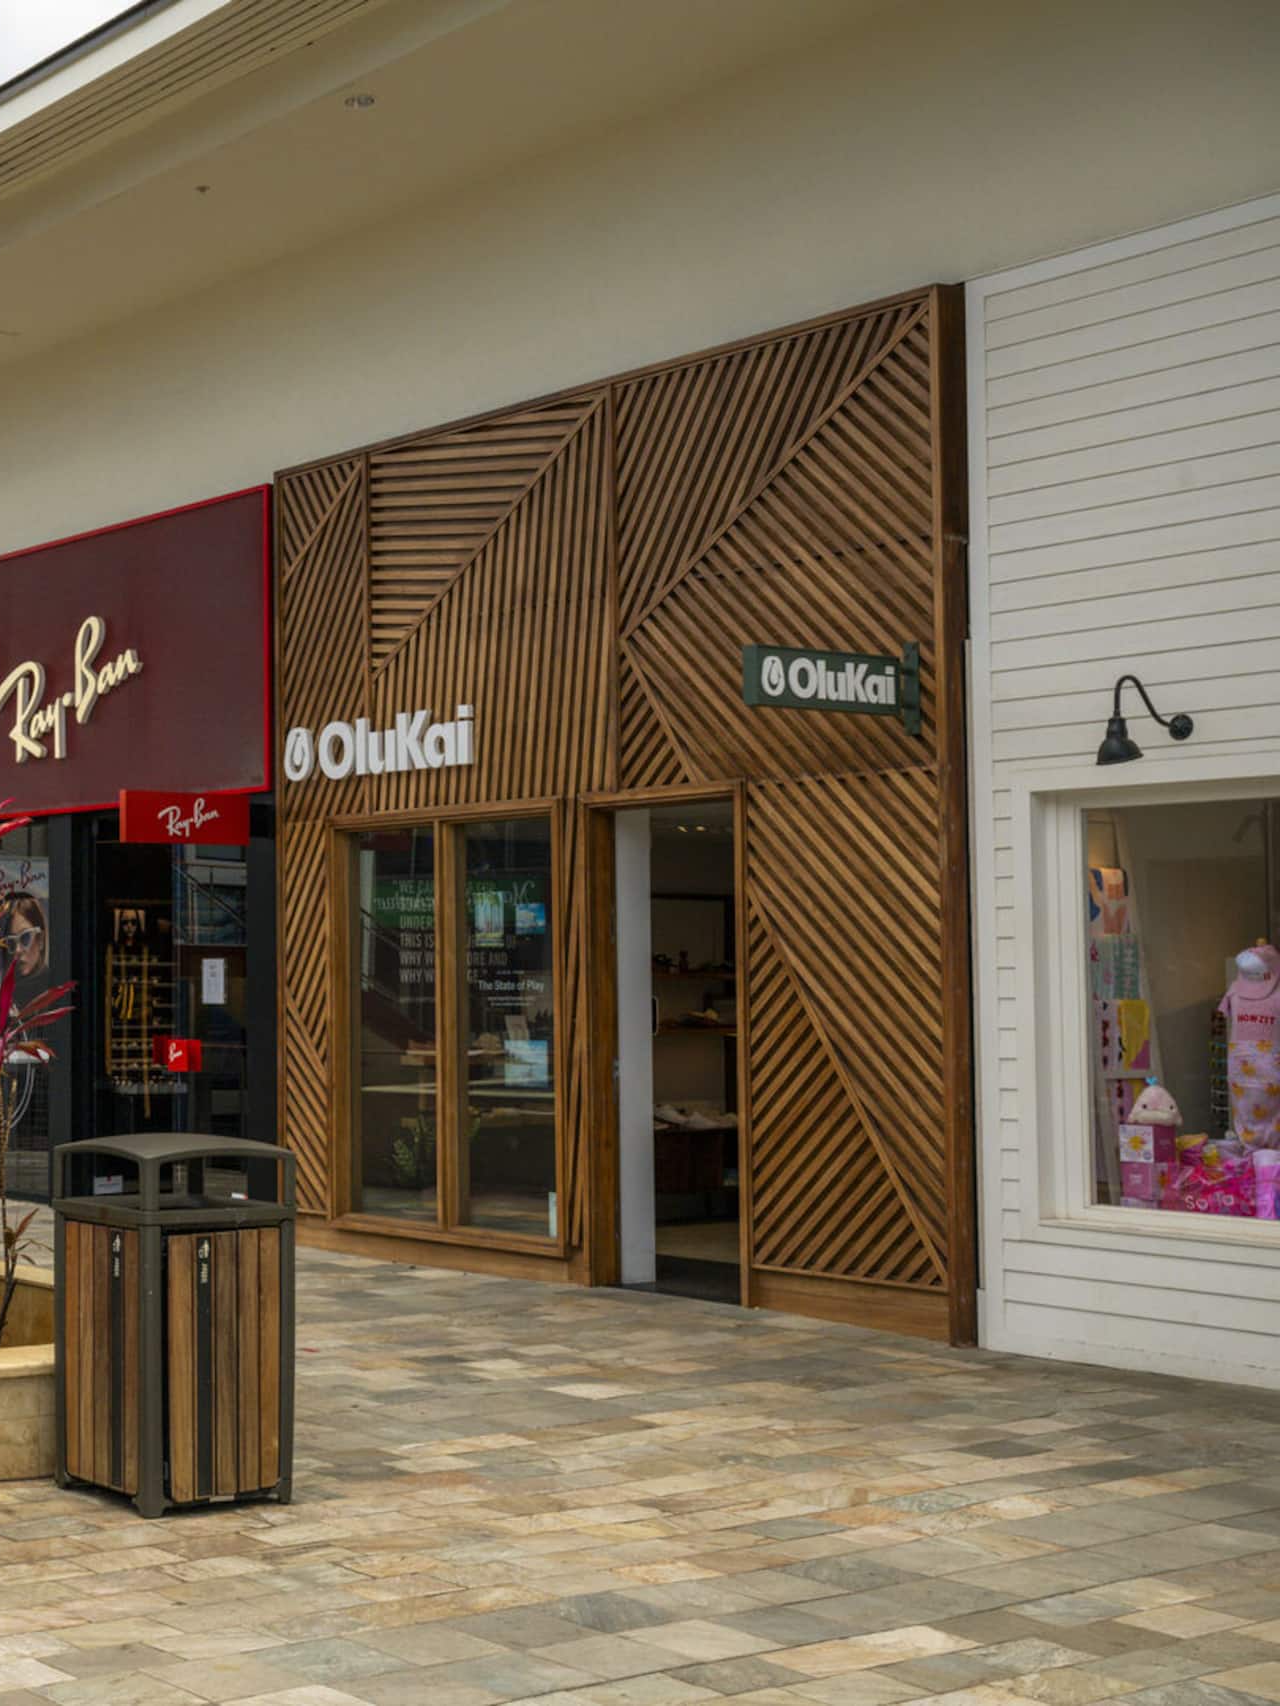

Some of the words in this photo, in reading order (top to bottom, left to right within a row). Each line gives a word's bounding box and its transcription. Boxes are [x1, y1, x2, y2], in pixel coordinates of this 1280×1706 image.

[788, 657, 896, 704] OluKai
[319, 704, 473, 780] OluKai
[479, 981, 493, 991] The
[494, 981, 516, 991] State
[517, 981, 525, 991] of
[527, 980, 544, 992] Play
